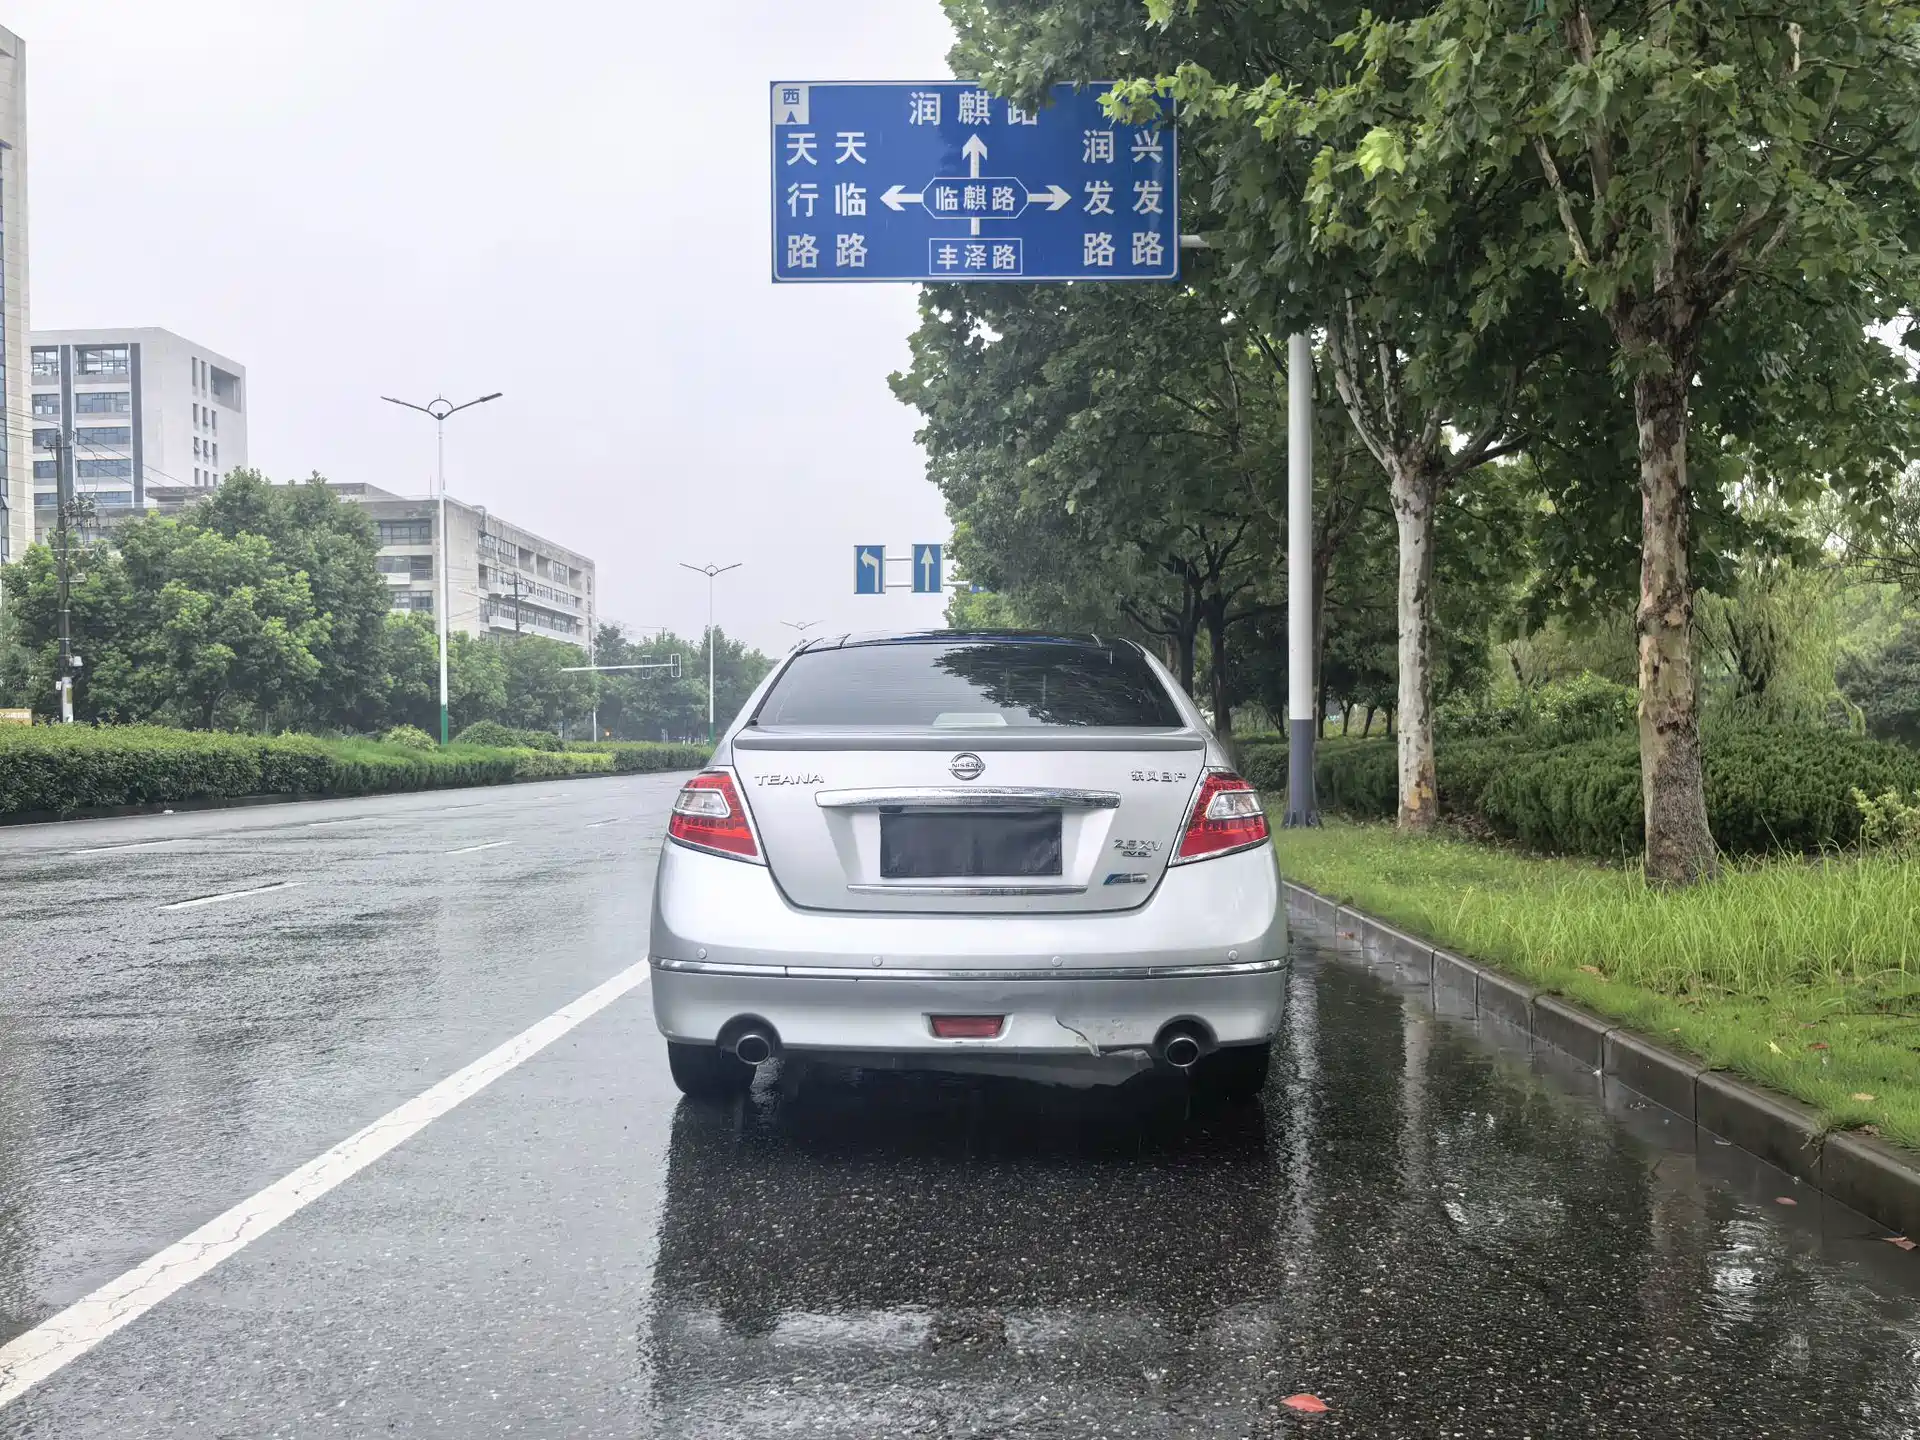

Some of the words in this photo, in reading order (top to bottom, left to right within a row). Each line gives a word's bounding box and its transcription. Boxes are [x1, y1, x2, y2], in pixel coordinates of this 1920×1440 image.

[782, 88, 800, 105] 西
[786, 132, 820, 269] 天行路
[834, 131, 868, 268] 天临路
[935, 185, 1016, 212] 临麒路
[1083, 130, 1116, 267] 润发路
[1131, 130, 1165, 266] 兴发路
[936, 244, 1017, 269] 丰泽路
[754, 772, 824, 786] TEANA
